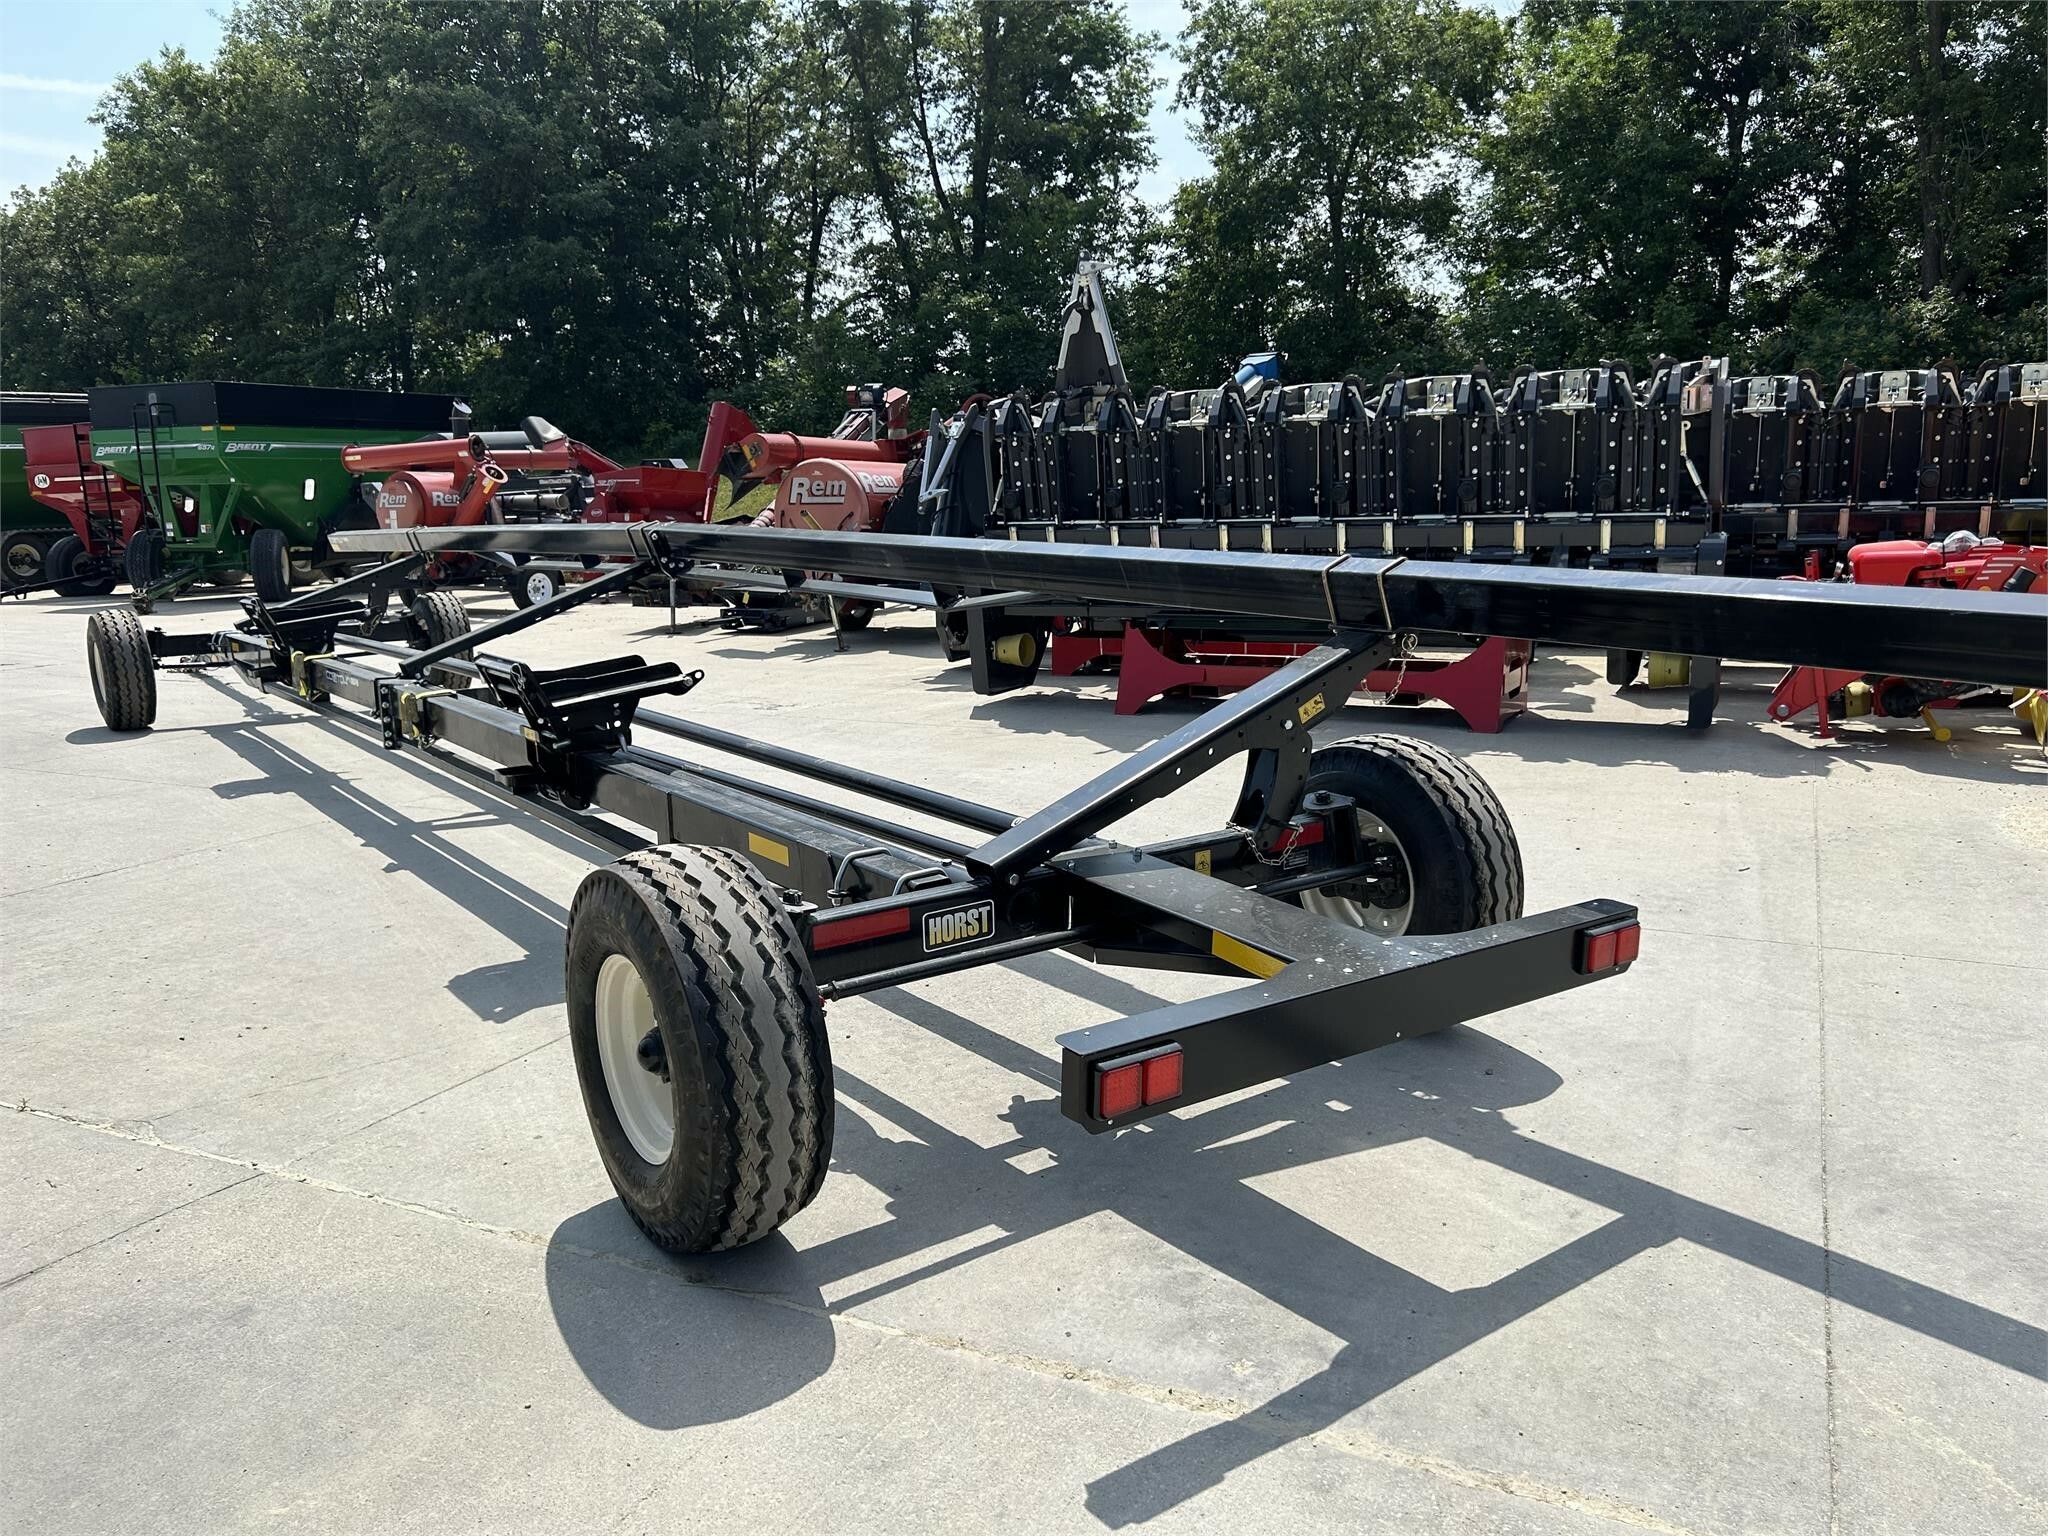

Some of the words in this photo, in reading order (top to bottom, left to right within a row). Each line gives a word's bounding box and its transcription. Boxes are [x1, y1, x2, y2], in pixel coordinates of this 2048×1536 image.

[95, 445, 128, 457] BRENT
[224, 442, 267, 453] BRENT
[790, 477, 847, 504] Rem
[858, 472, 899, 494] Rem
[379, 492, 407, 508] Rem
[928, 905, 991, 946] HORST
